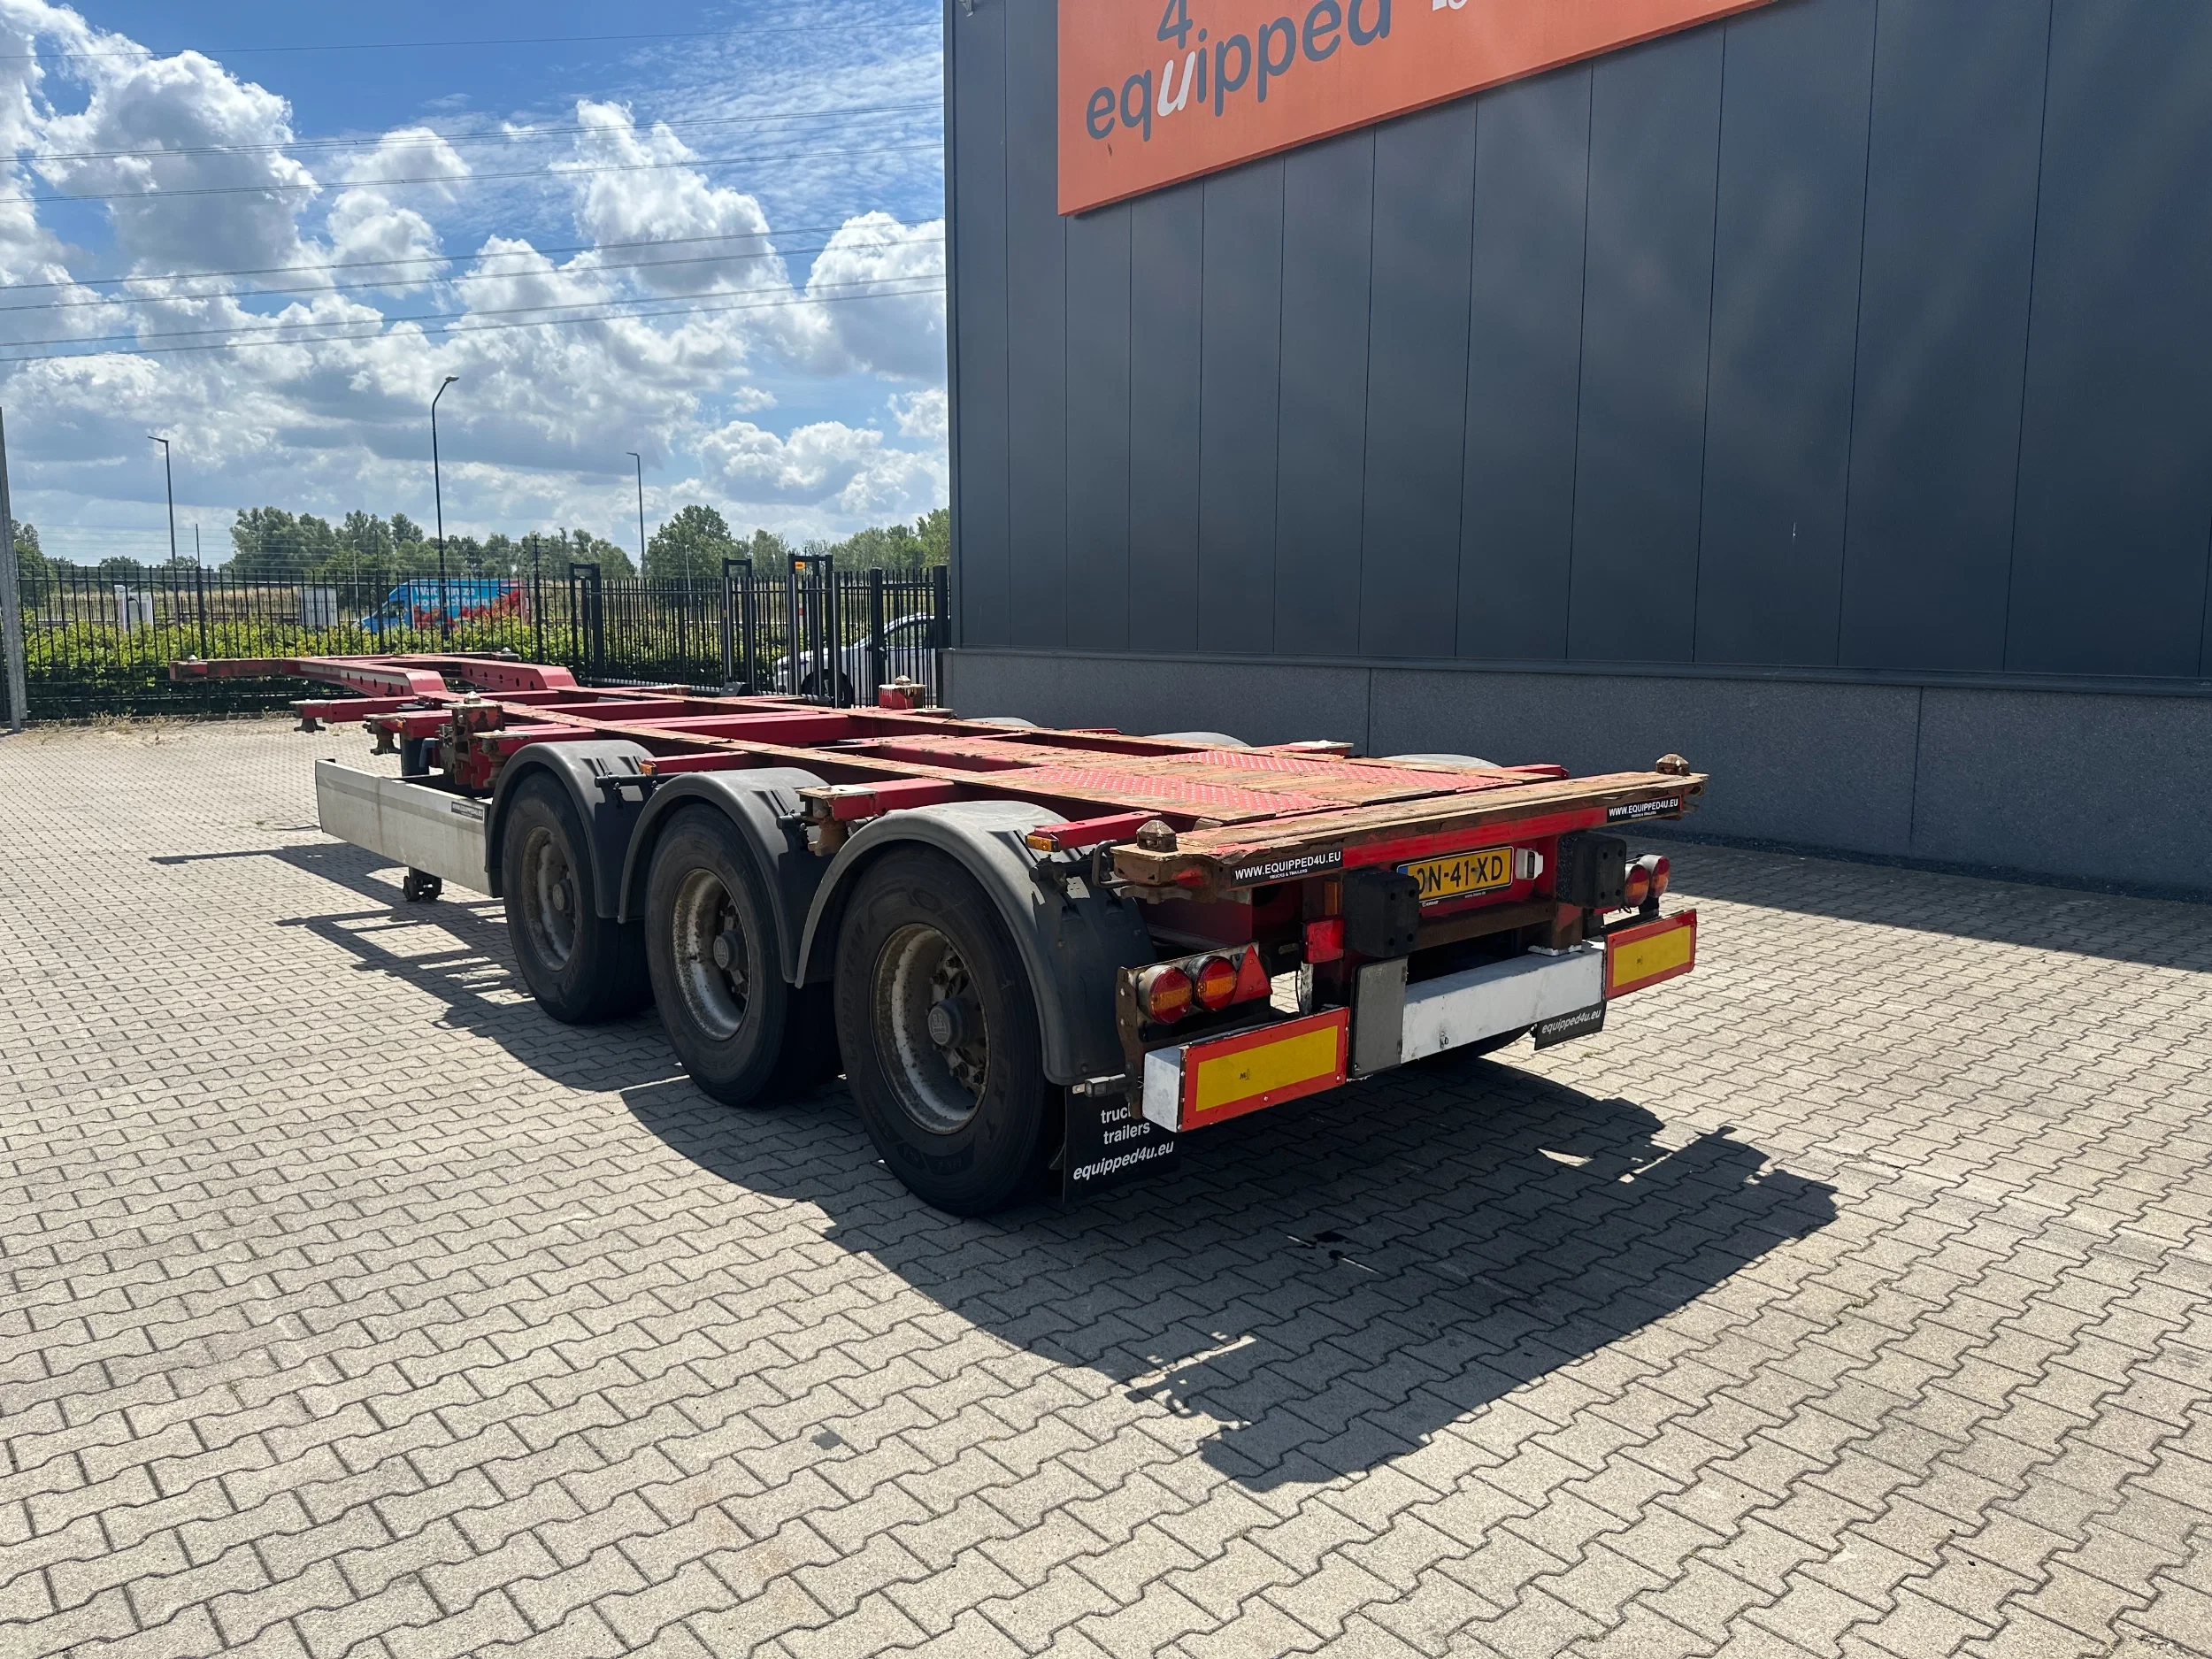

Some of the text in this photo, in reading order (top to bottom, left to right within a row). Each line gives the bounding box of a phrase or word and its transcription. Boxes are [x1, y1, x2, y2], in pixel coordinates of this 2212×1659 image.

[1609, 798, 1678, 817] WWW.EQUIPPED4U.EU
[1234, 851, 1341, 880] WWW.EQUIPPED4U.EU
[1541, 1010, 1601, 1034] equipped4u.eu
[1103, 1122, 1151, 1145] trailers
[1072, 1141, 1174, 1180] equipped4u.eu
